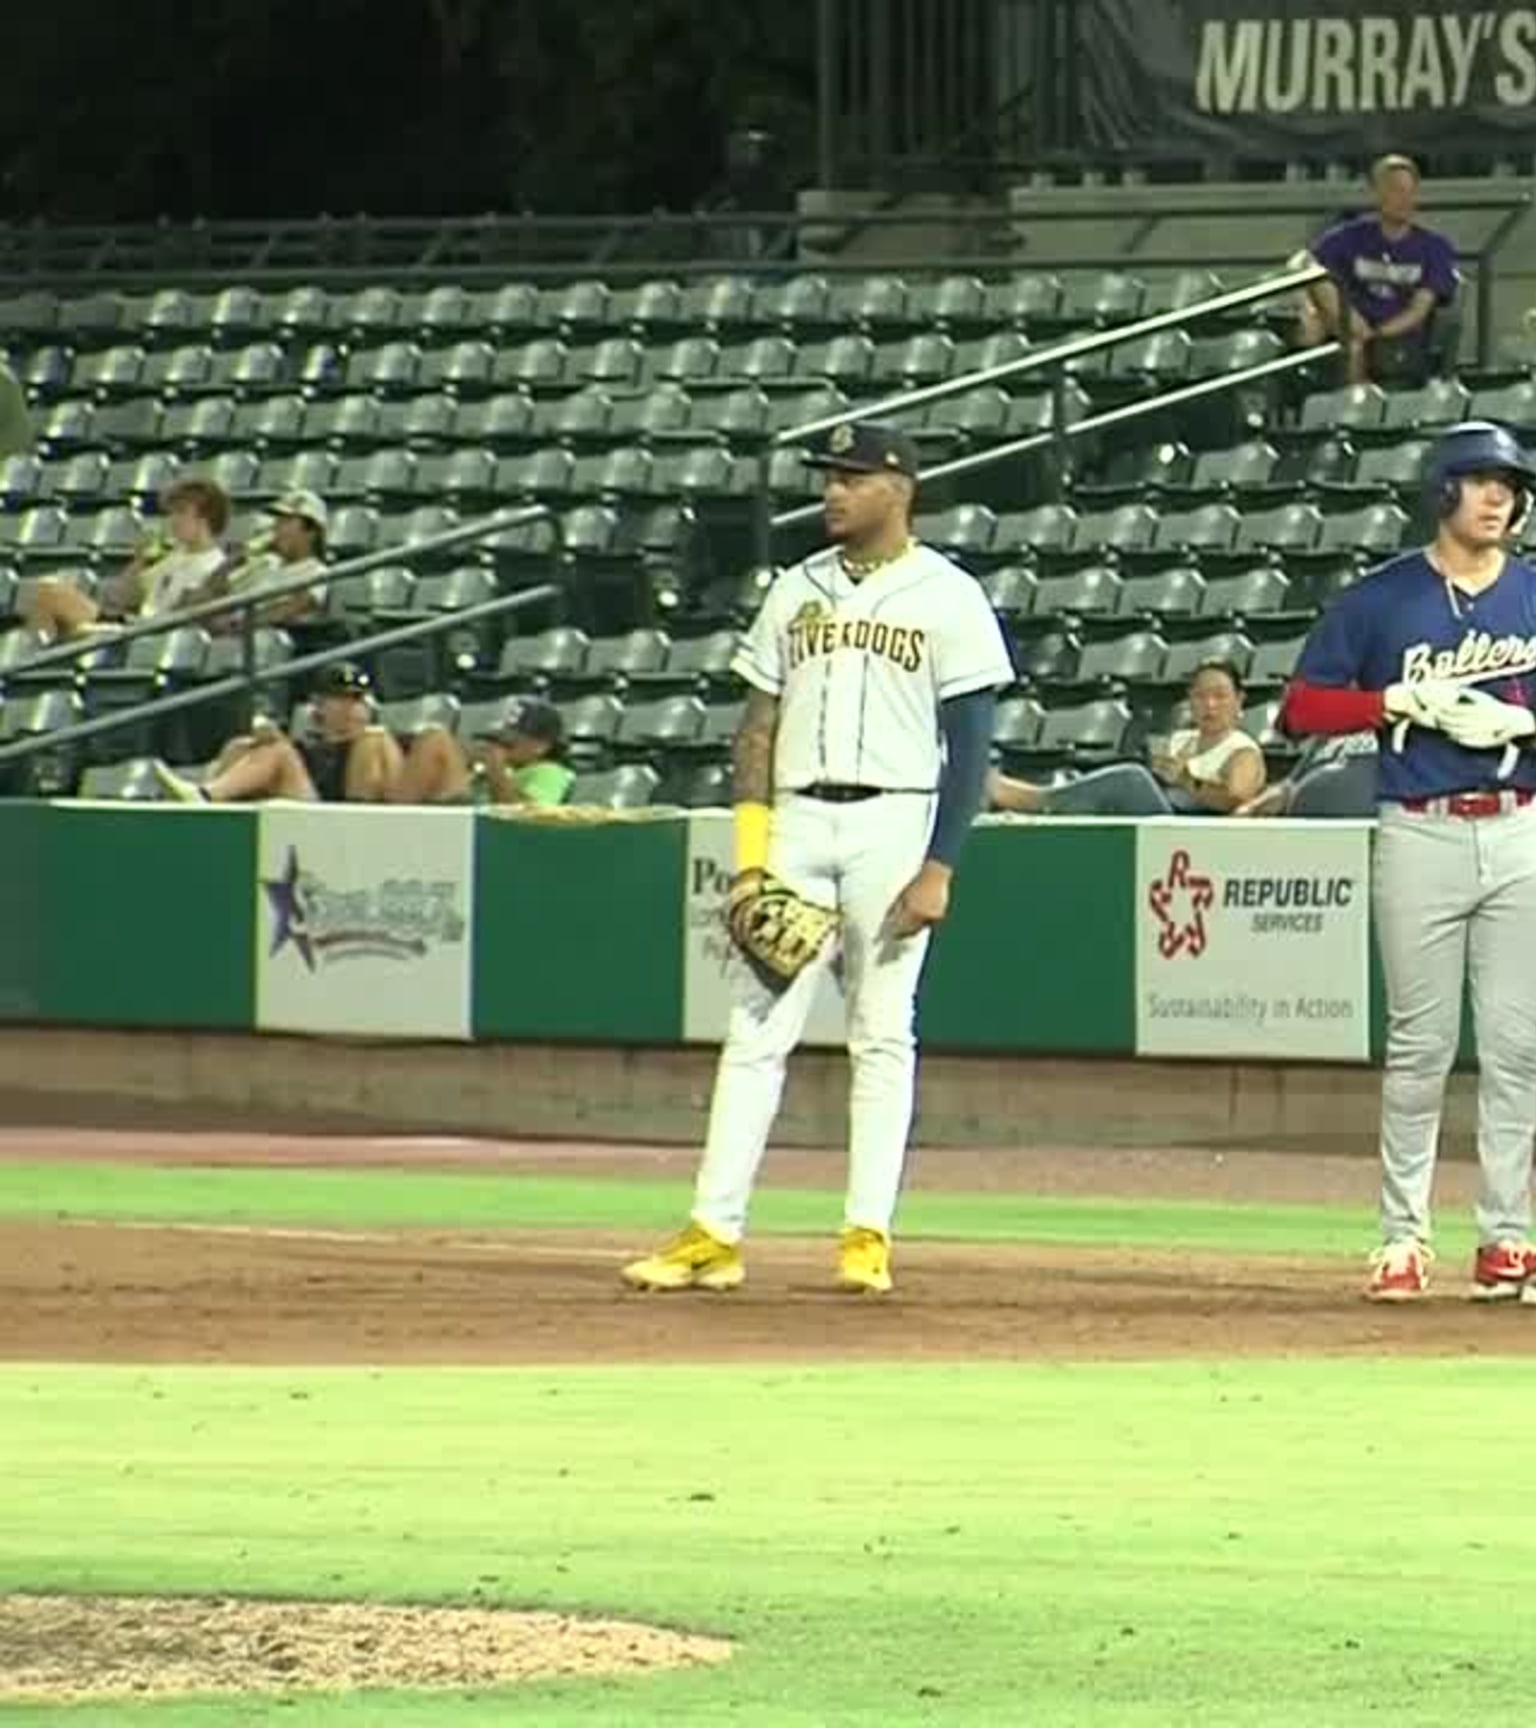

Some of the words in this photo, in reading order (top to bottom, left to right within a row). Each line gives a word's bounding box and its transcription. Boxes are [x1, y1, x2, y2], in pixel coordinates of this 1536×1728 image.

[1223, 877, 1353, 908] REPUBLIC
[1251, 912, 1324, 933] SERVICES
[1148, 995, 1267, 1026] Sustainability
[1273, 999, 1290, 1018] in
[1295, 997, 1353, 1019] Action
